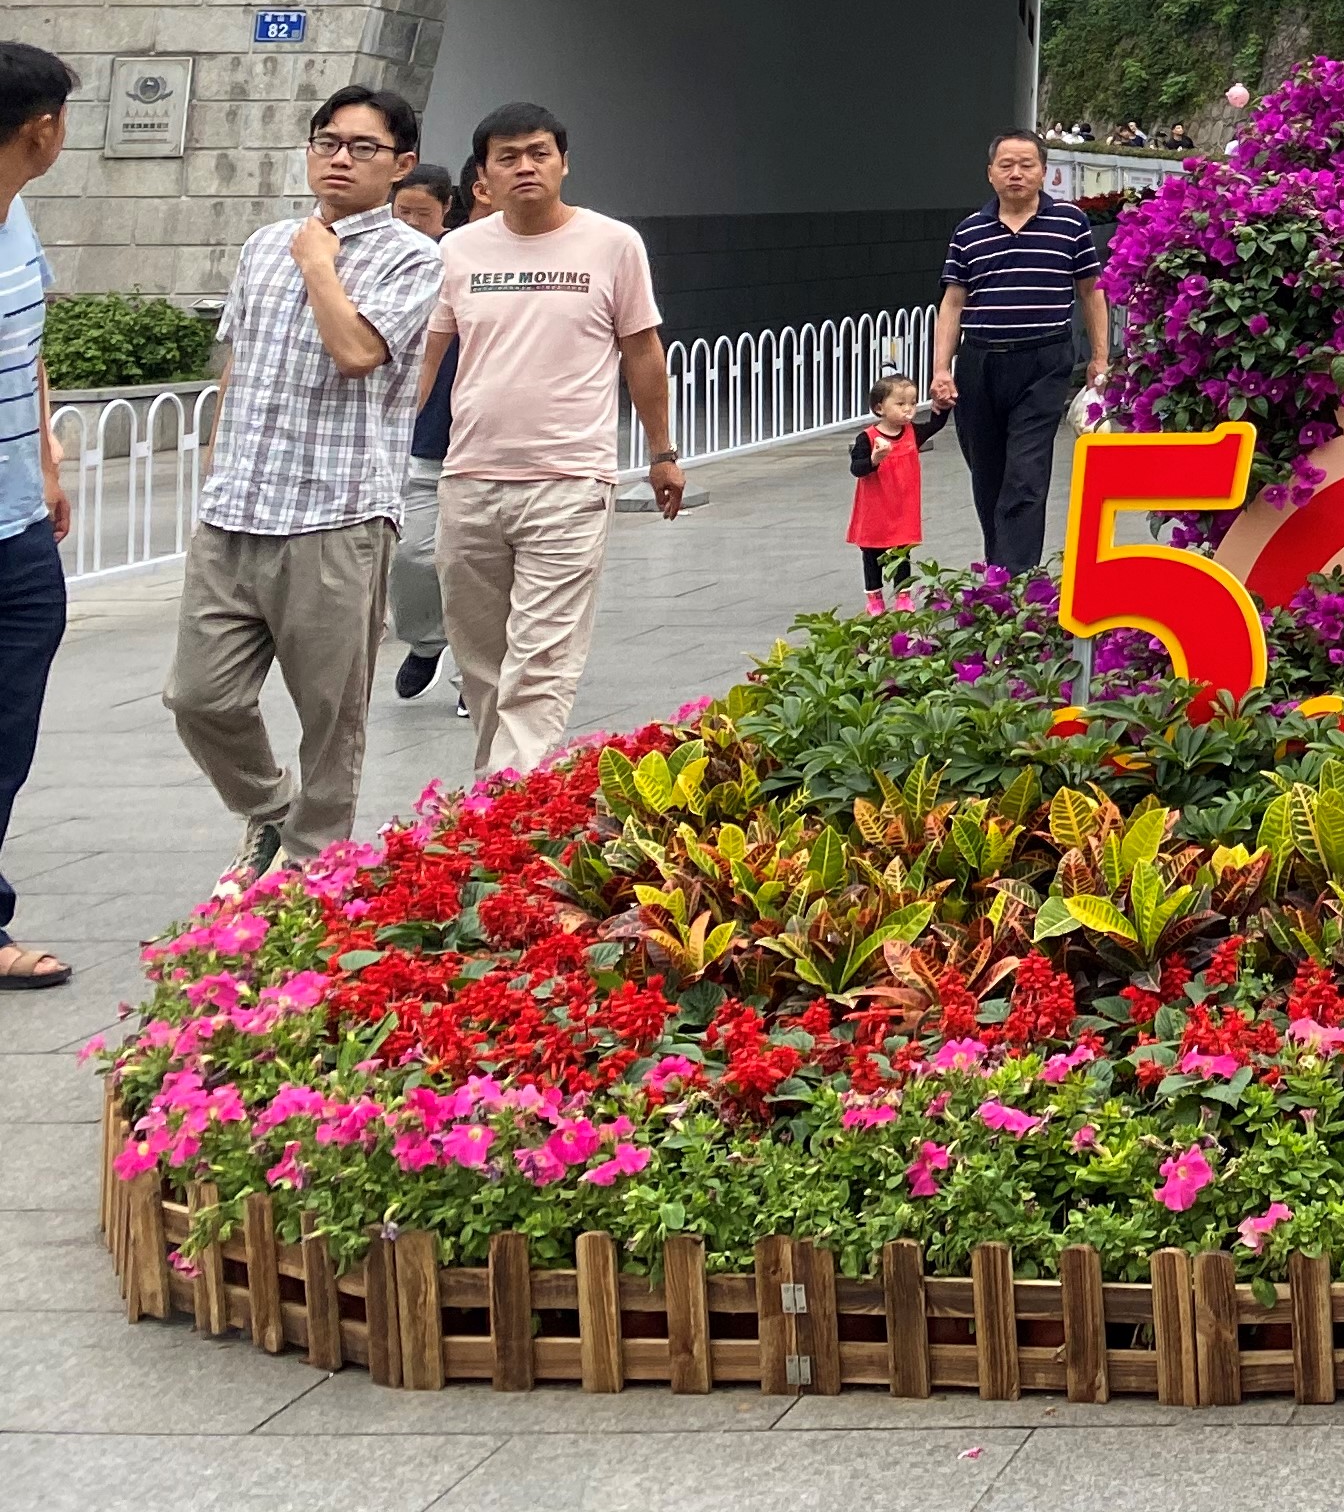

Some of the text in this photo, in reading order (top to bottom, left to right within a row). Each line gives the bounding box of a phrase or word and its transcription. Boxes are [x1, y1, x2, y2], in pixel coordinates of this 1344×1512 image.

[267, 23, 289, 38] 82
[471, 271, 591, 285] KEEP MOVING
